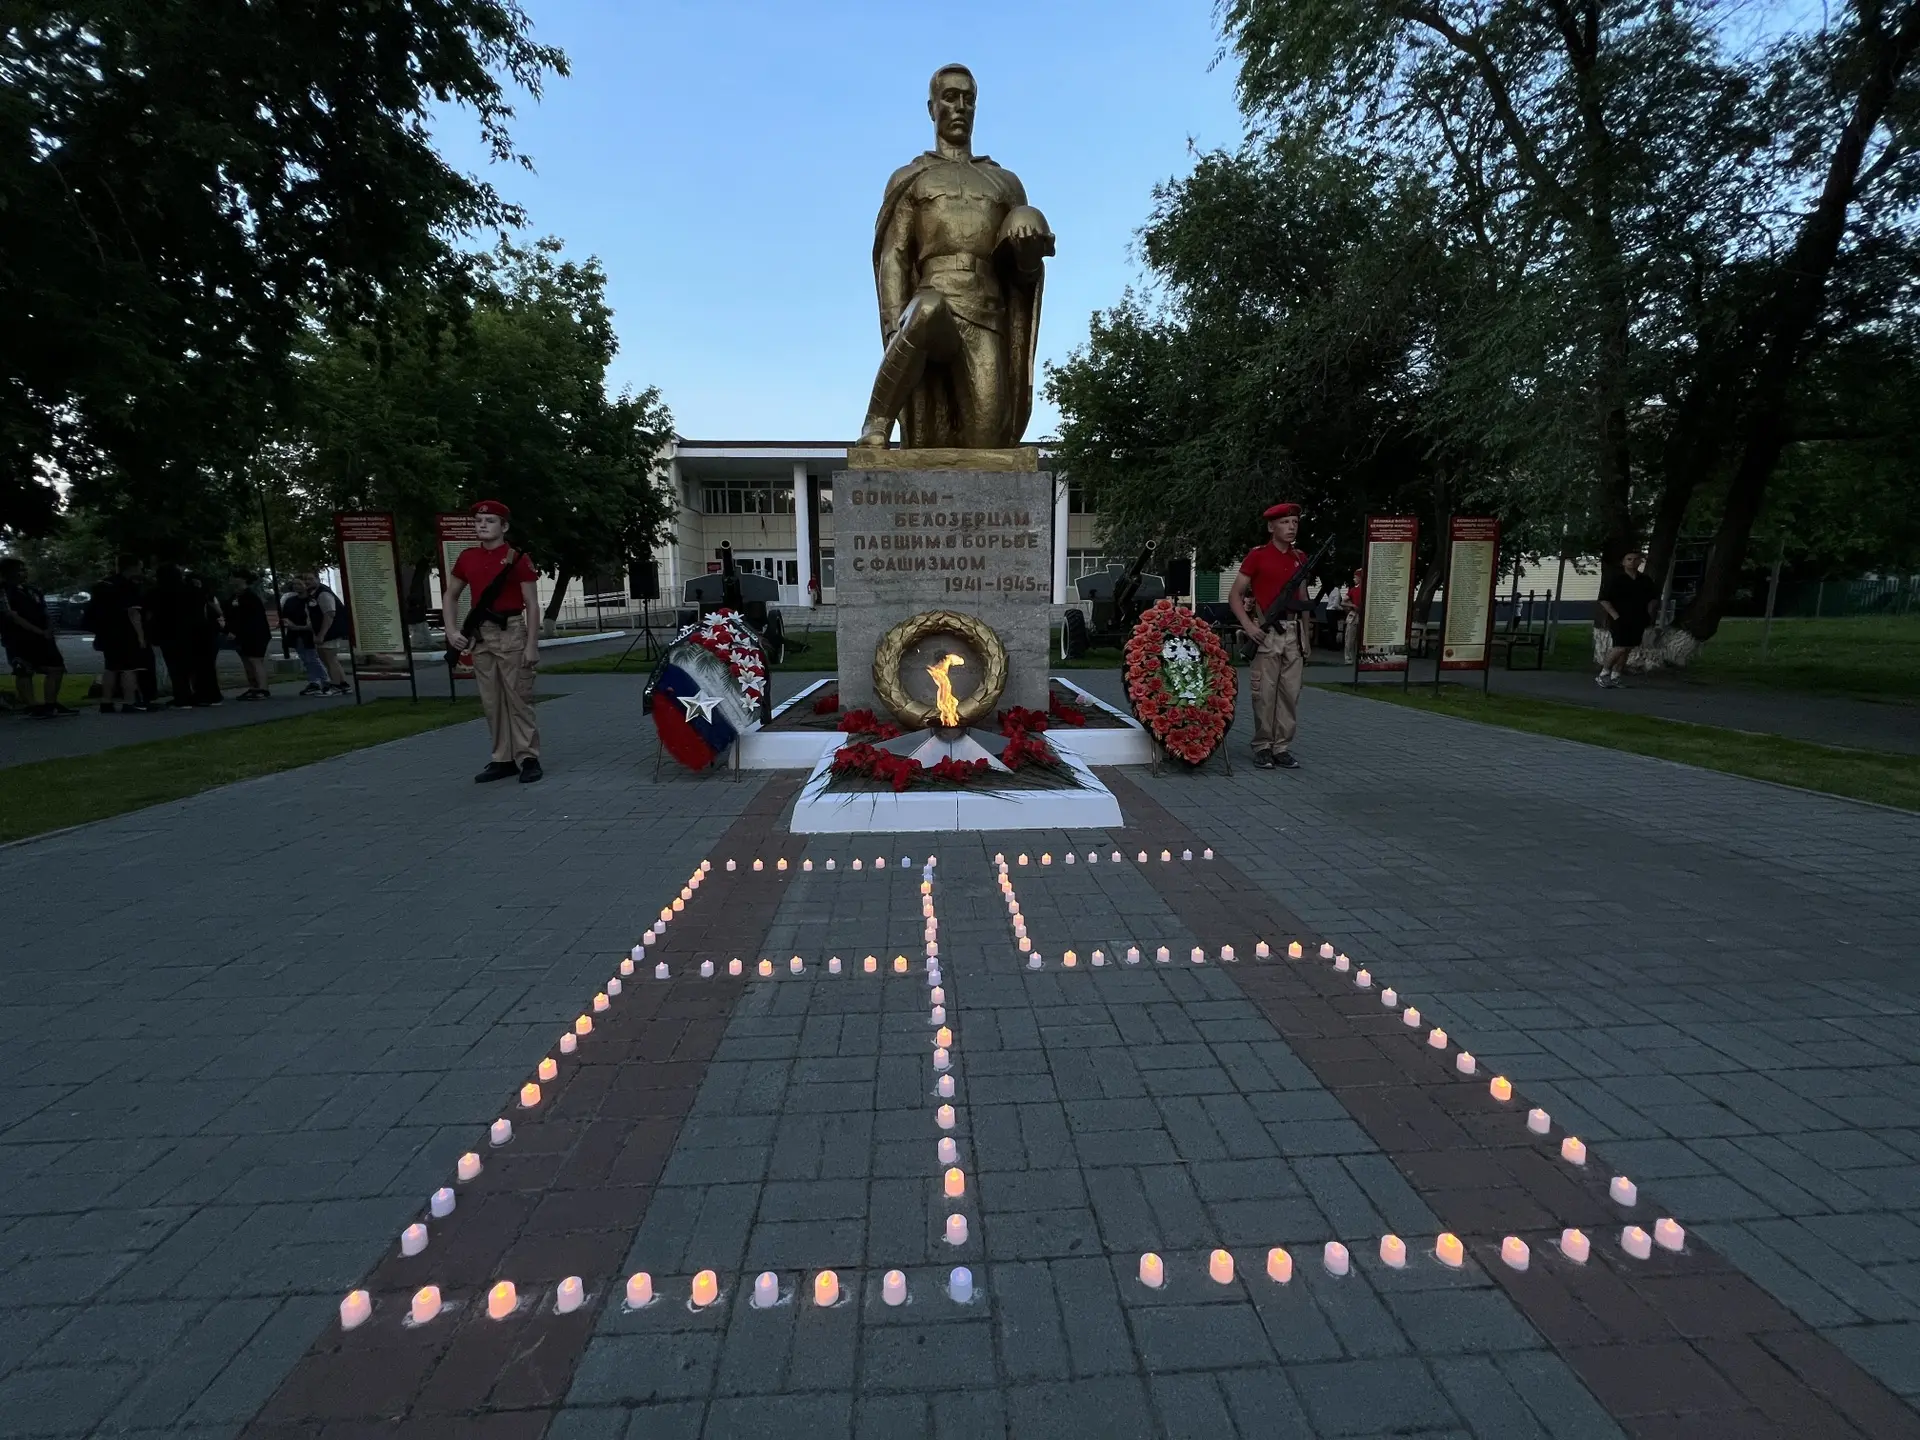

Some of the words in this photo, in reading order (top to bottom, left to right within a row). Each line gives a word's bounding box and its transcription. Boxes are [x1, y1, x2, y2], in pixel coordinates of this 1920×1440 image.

[895, 512, 1030, 527] БЕЛОЗЕРЦАМ
[853, 535, 940, 550] ПАВШИМ
[945, 535, 956, 548] В
[853, 557, 864, 571] С
[870, 556, 985, 571] ФАШИЗМОМ
